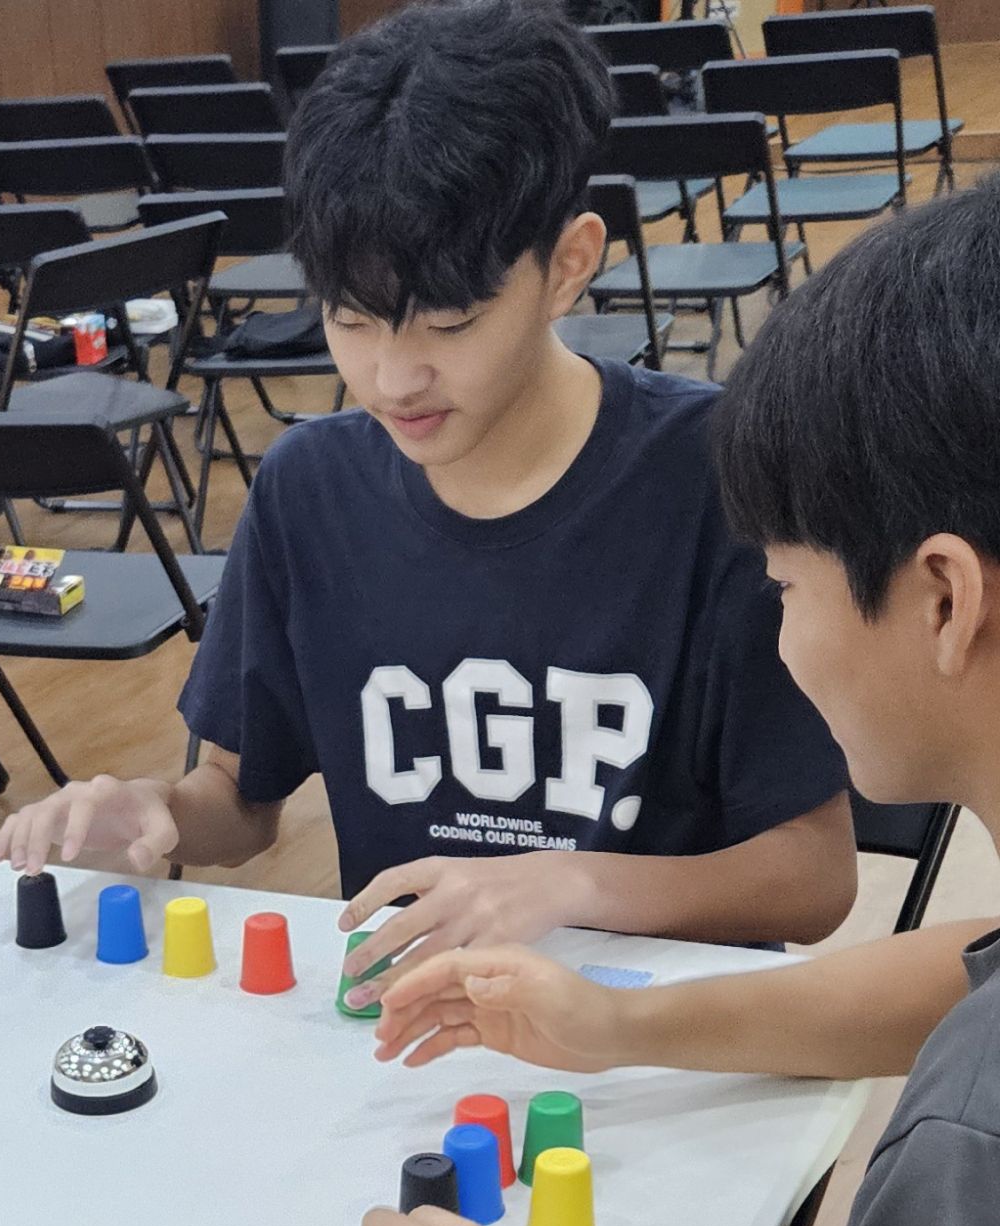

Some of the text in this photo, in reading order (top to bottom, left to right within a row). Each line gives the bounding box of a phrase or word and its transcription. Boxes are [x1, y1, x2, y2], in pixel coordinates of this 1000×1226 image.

[456, 812, 543, 833] WORLDWIDE
[429, 825, 577, 851] CODING OUR DREAMS
